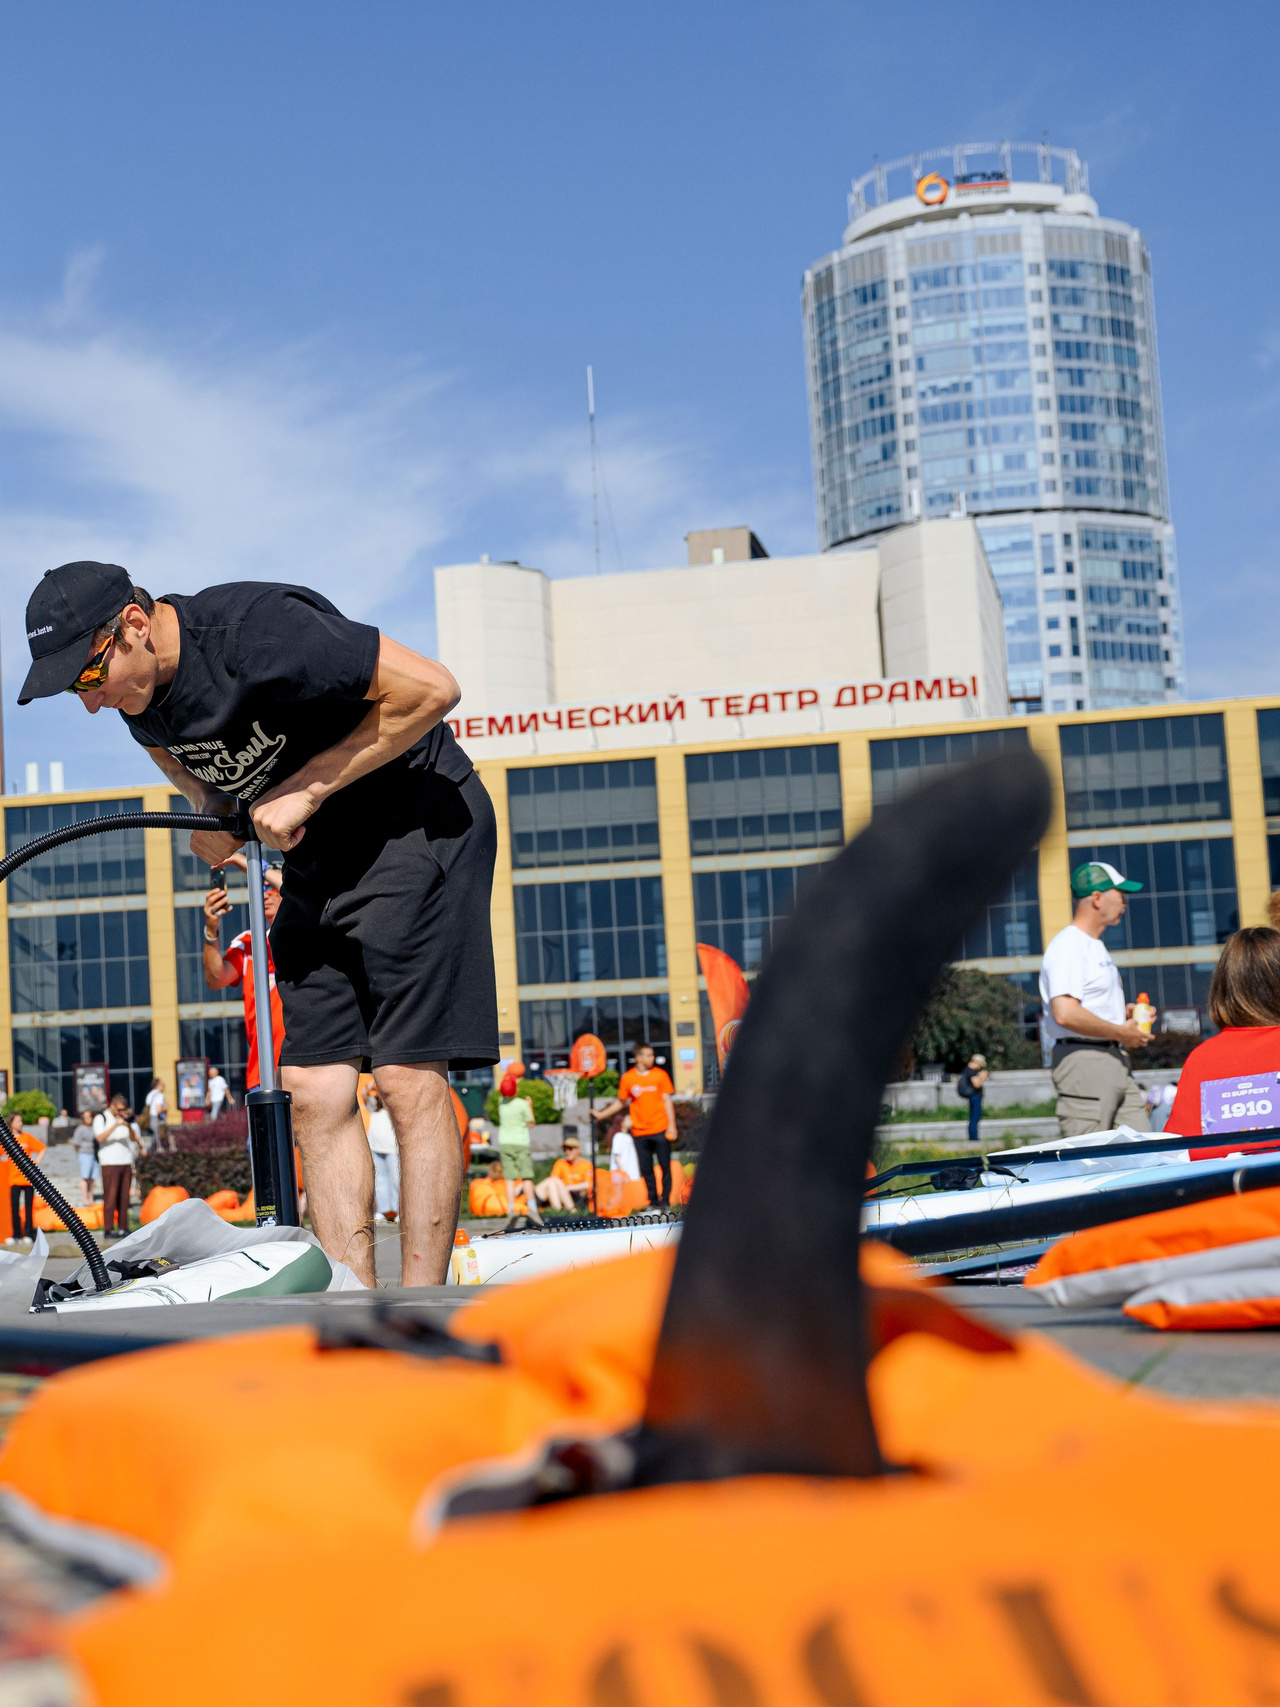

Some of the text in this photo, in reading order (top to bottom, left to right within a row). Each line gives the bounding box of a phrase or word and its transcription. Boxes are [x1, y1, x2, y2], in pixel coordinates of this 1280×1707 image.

[700, 689, 820, 718] ТЕАТР
[834, 675, 979, 709] ДРАМЫ
[196, 740, 226, 750] TRUE
[214, 721, 277, 780] Soul
[1232, 1089, 1248, 1097] SUP
[1248, 1087, 1270, 1095] FEST
[1221, 1099, 1273, 1119] 1910
